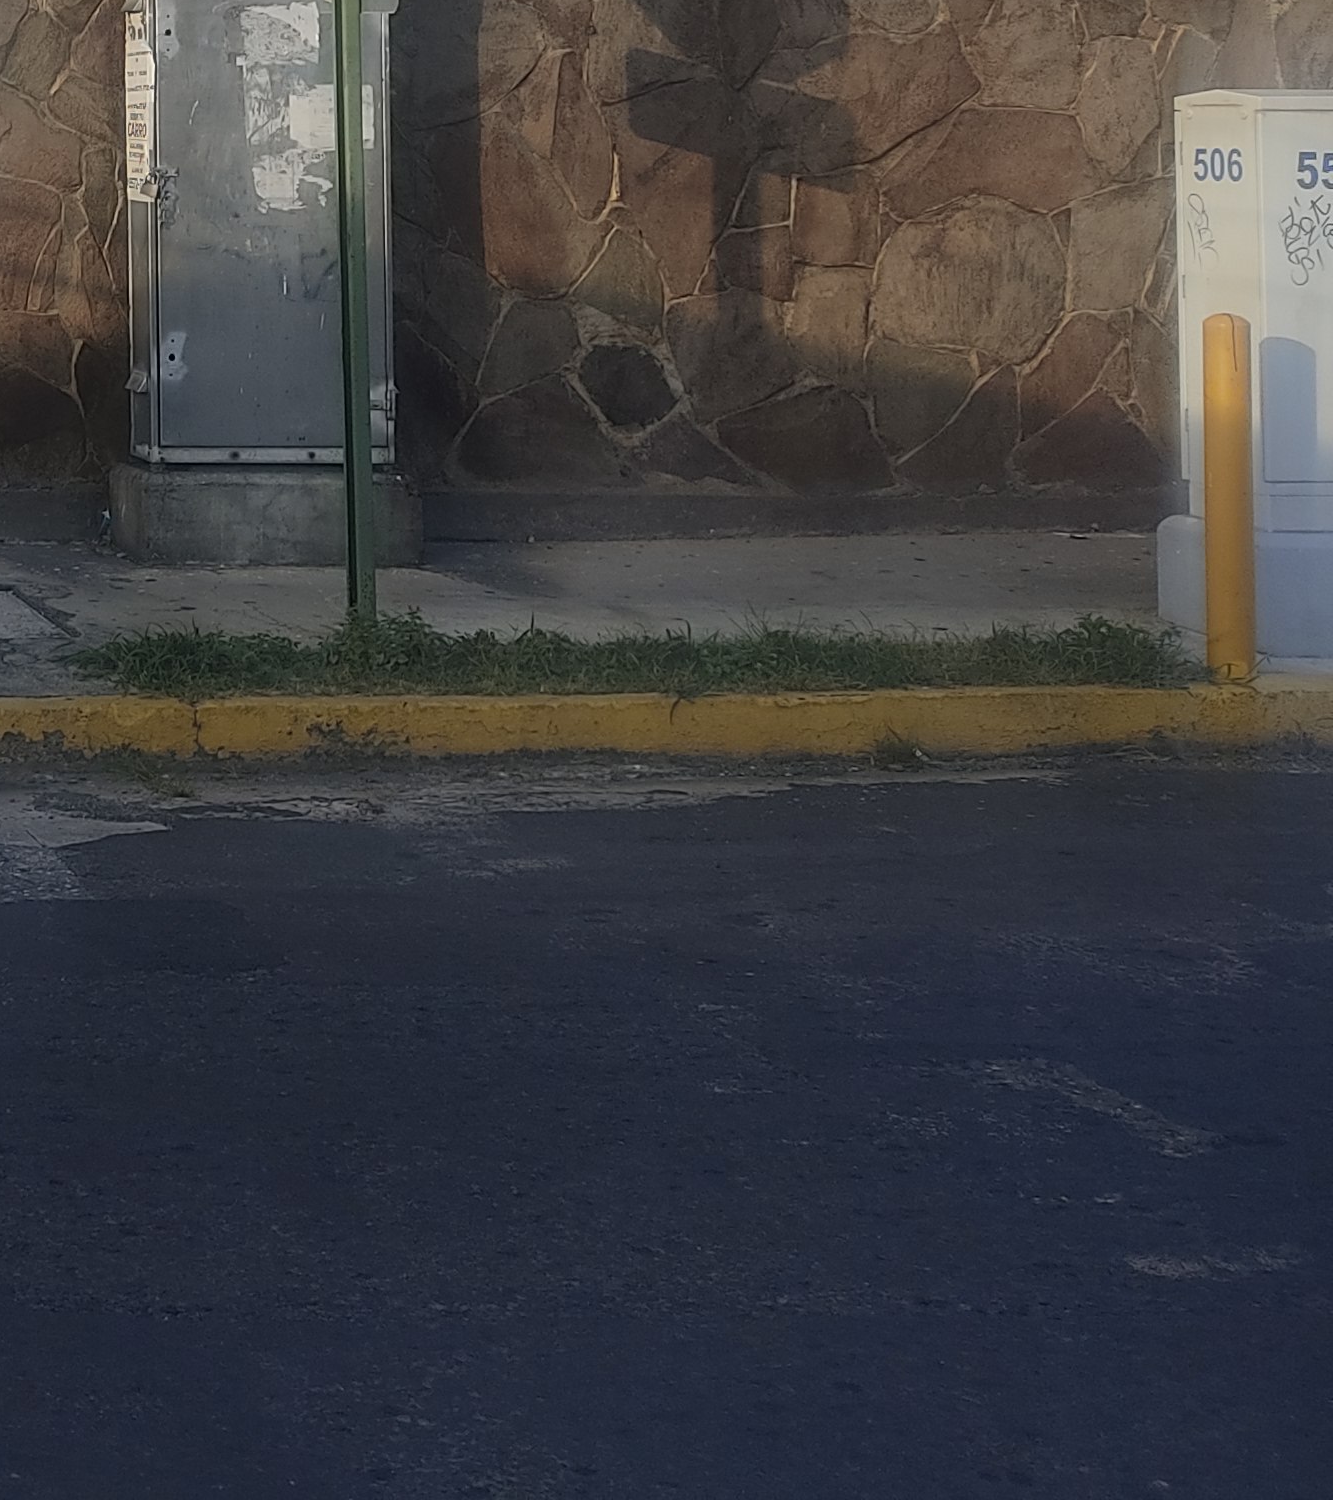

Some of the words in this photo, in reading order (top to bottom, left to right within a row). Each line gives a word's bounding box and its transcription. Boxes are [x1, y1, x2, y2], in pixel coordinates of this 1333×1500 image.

[128, 122, 147, 138] CARRO
[1194, 148, 1243, 181] 506
[1296, 152, 1333, 190] 55
